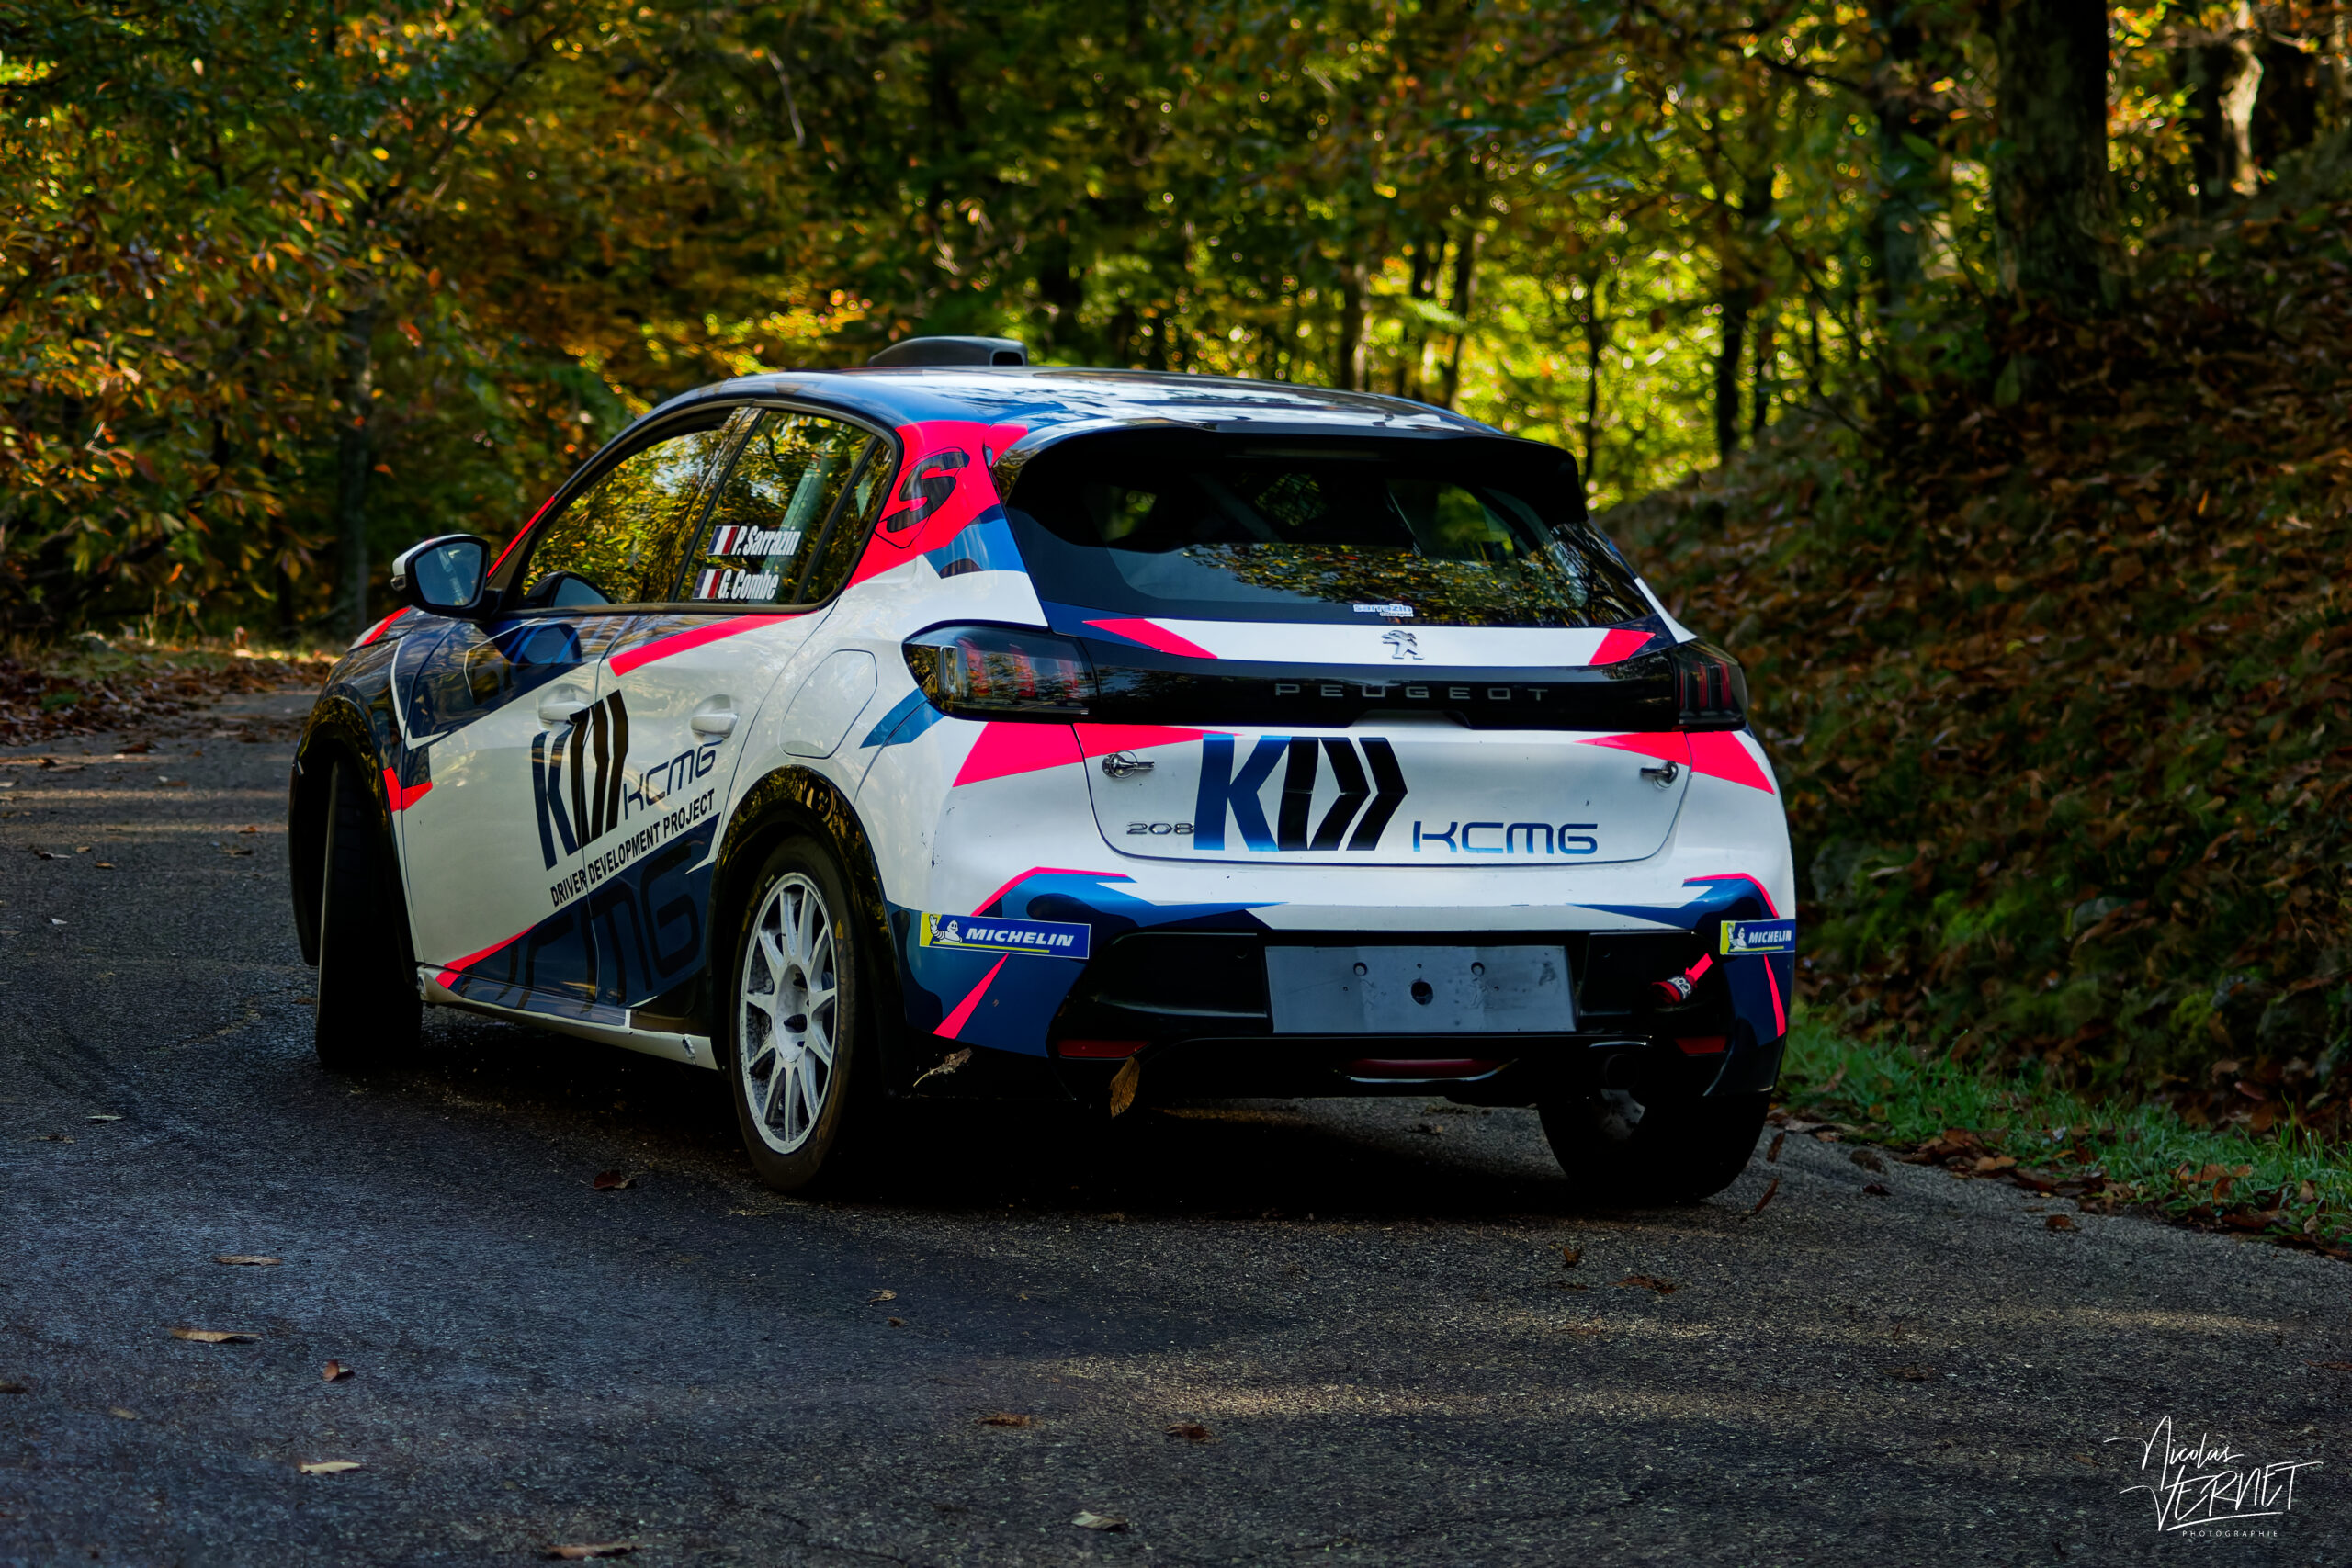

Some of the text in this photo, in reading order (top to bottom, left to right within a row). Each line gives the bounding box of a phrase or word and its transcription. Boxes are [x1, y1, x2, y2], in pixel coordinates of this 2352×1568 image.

[730, 525, 801, 556] P. Sarrazin
[718, 569, 779, 600] G. Combe
[1275, 683, 1549, 701] PEUGEOT
[1126, 823, 1194, 835] 208
[1413, 821, 1598, 854] KCMG
[550, 787, 715, 908] DRIVER DEVELOPMENT PROJECT
[966, 928, 1074, 947] MICHELIN
[1748, 930, 1792, 943] MICHELIN
